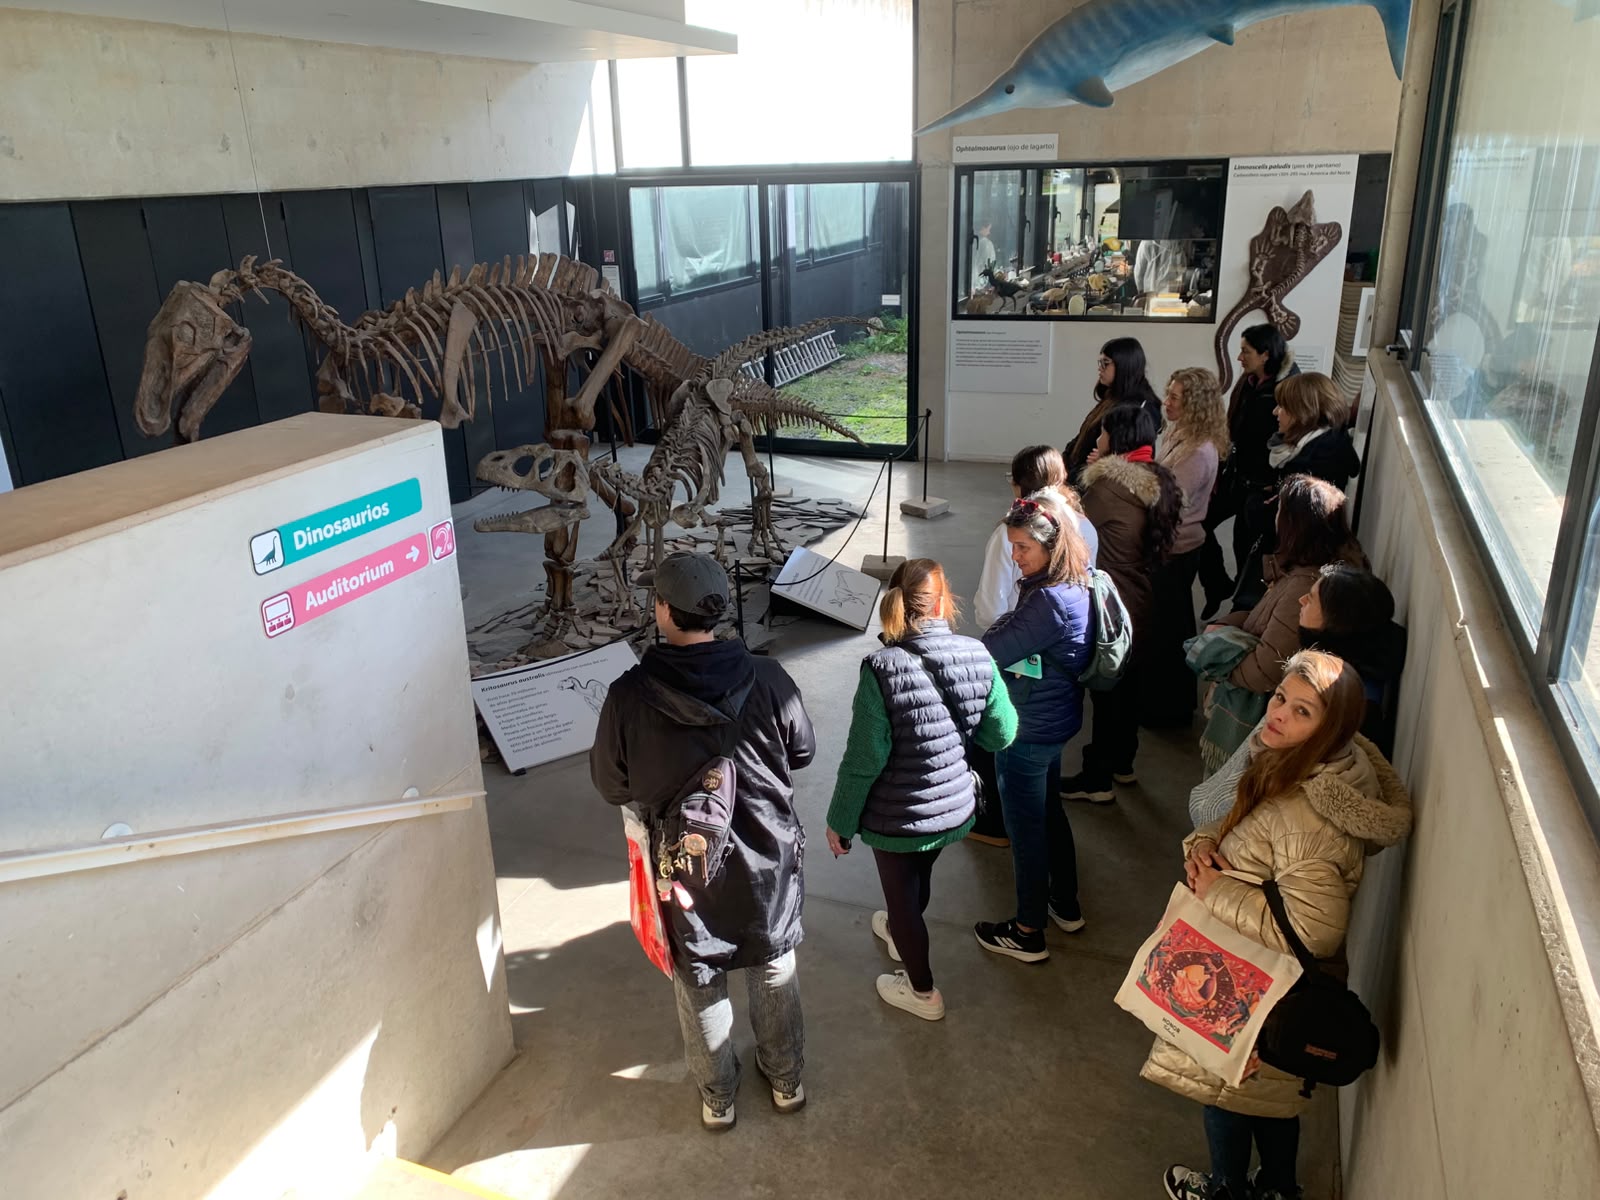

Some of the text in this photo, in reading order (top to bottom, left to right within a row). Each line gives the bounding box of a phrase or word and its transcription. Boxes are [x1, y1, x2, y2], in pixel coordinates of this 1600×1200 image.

[1007, 144, 1019, 152] (ojo
[1030, 143, 1055, 151] lagarto)
[293, 502, 390, 551] Dinosaurios
[305, 560, 395, 611] Auditorium
[480, 680, 518, 693] Kritosaurus
[519, 673, 546, 684] australis
